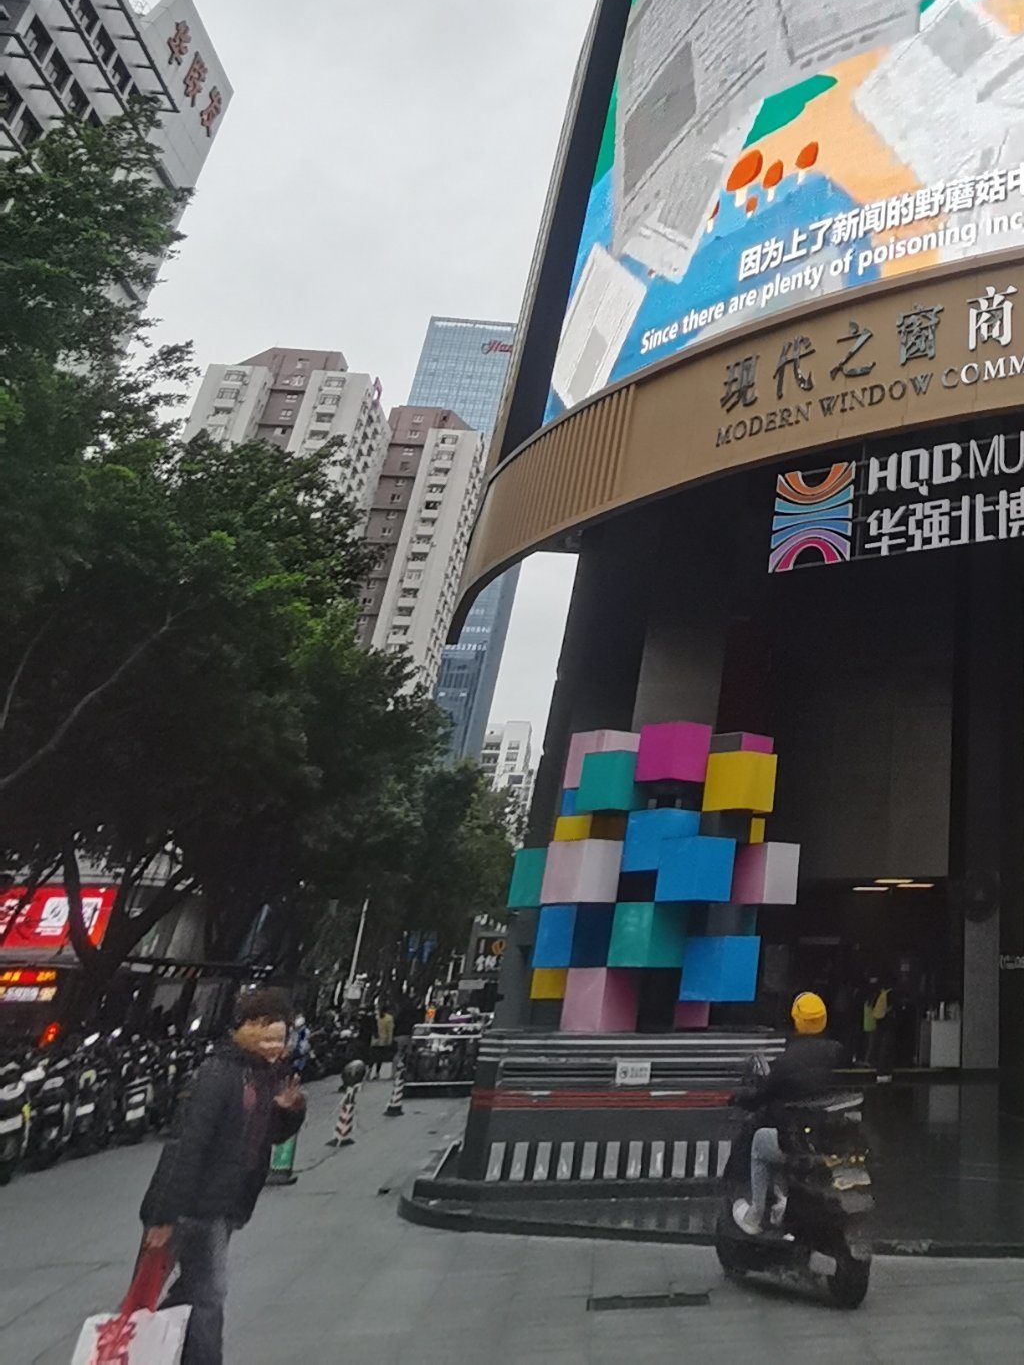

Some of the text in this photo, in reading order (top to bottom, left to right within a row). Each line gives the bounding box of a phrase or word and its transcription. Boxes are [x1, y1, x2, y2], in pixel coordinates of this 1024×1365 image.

[640, 321, 678, 354] Since
[682, 302, 724, 334] there
[728, 288, 757, 314] are
[760, 266, 824, 308] plenty
[829, 249, 856, 276] of
[858, 220, 977, 275] poisoning
[714, 401, 812, 448] MODERN
[818, 371, 934, 418] WINDOW
[867, 441, 963, 497] HQB
